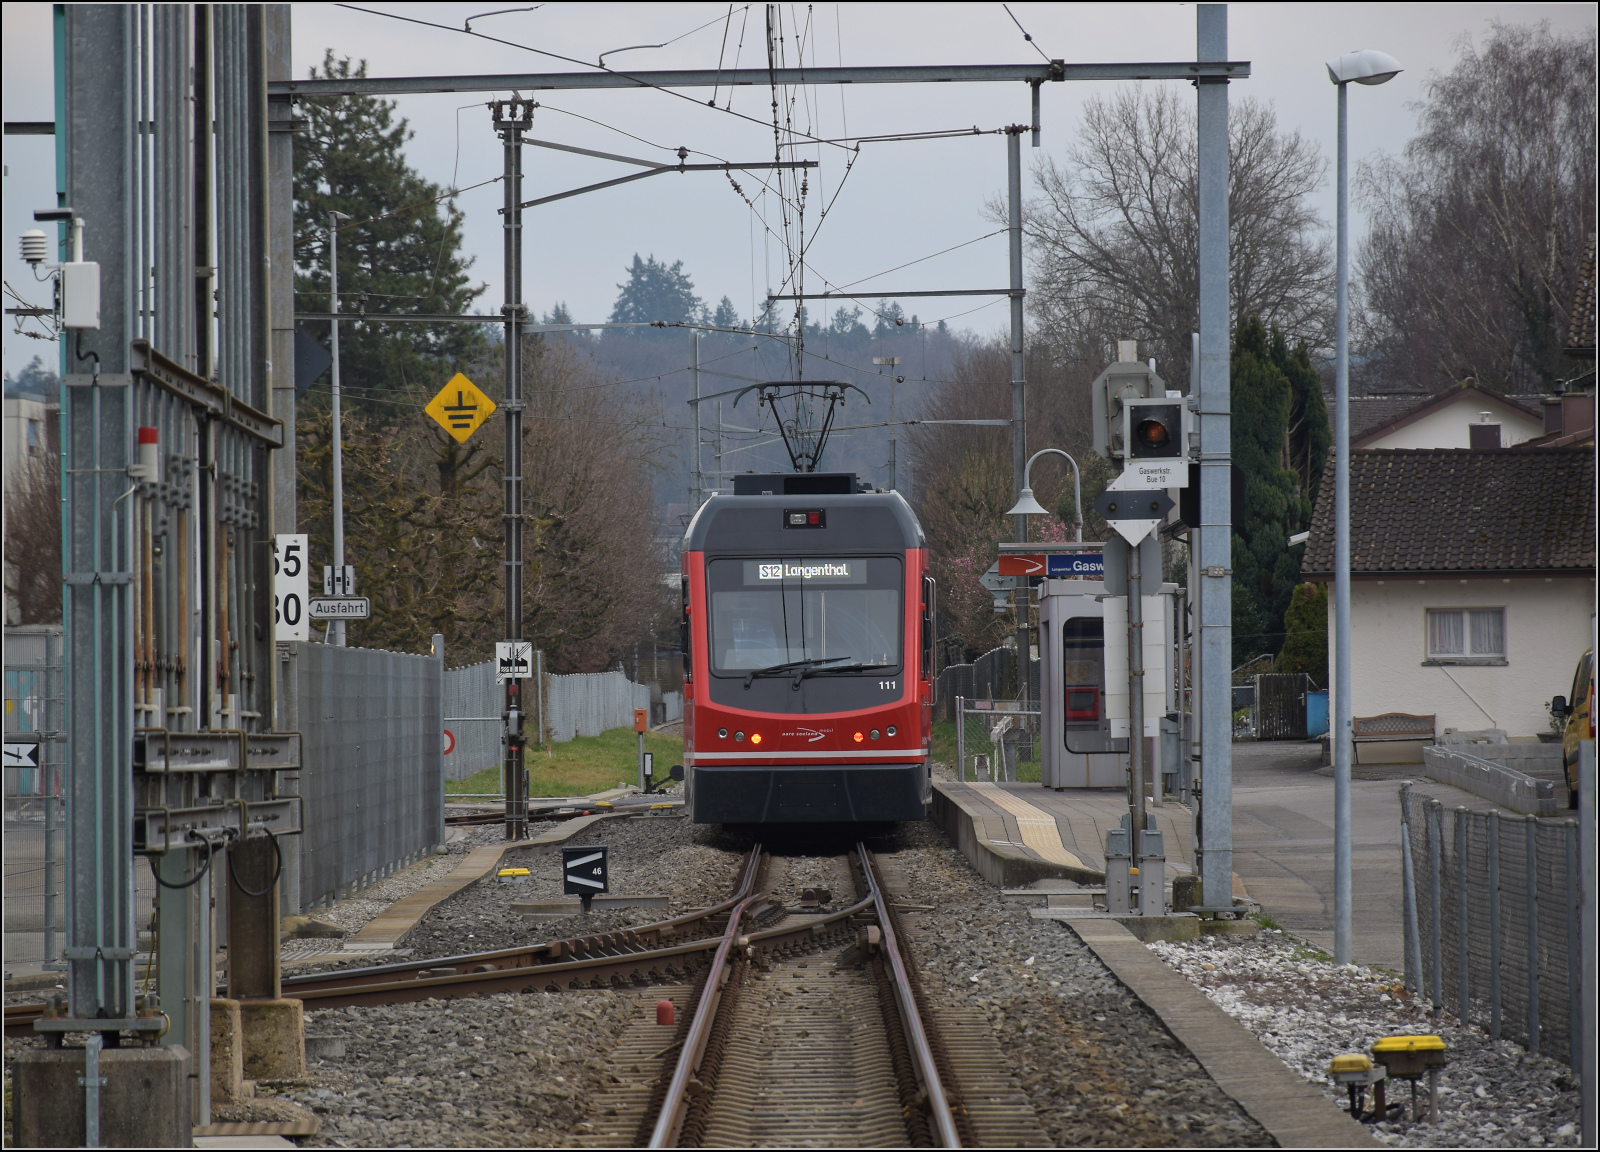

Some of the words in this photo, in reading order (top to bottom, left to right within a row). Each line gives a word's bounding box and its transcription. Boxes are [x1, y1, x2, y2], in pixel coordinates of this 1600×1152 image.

[1138, 467, 1172, 475] Gaswerkstr.
[1146, 475, 1158, 483] Bue
[1159, 475, 1166, 483] 10
[274, 545, 301, 577] 5
[760, 565, 782, 579] S12
[785, 563, 849, 579] Langenthal
[274, 593, 301, 626] 0
[315, 602, 365, 614] Ausfahrt
[878, 680, 896, 690] 111
[592, 867, 602, 875] 46
